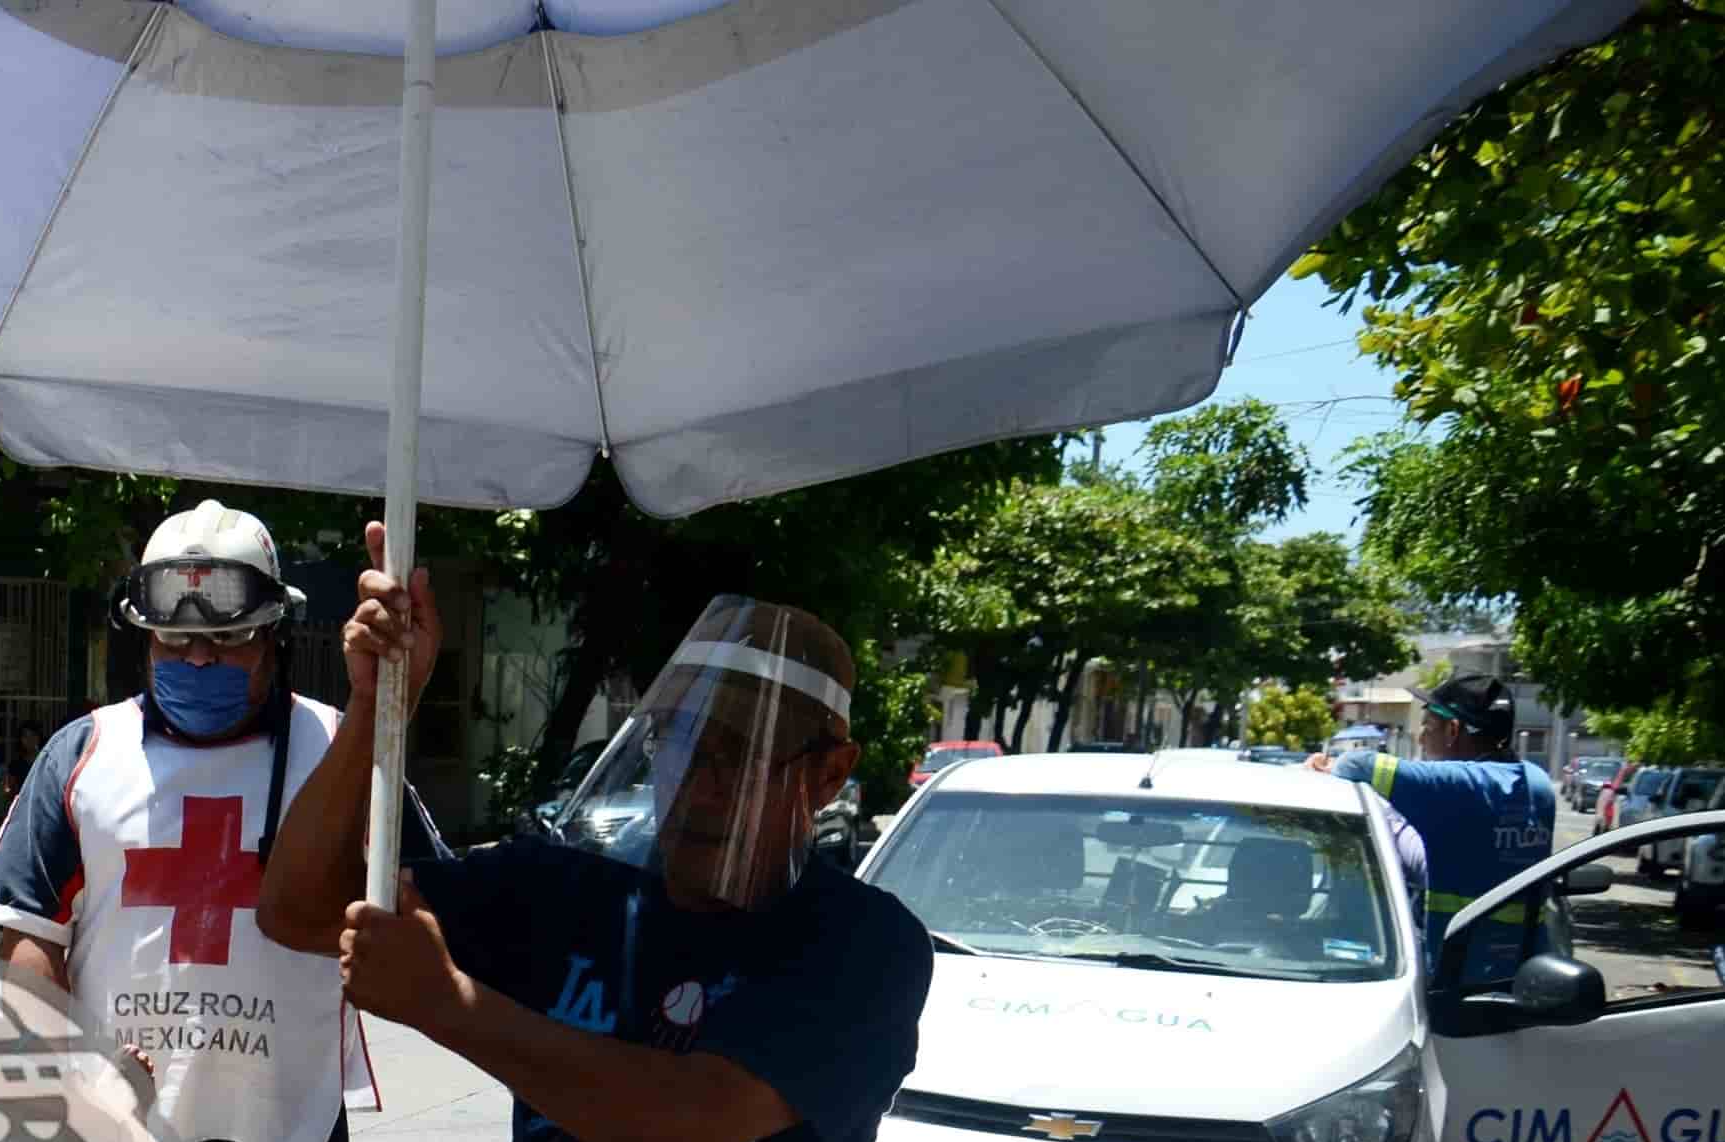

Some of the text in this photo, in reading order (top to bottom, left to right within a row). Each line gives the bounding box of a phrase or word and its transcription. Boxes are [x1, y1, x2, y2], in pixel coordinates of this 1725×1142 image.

[114, 991, 276, 1025] CRUZ ROJA
[114, 1026, 271, 1058] MEXICANA
